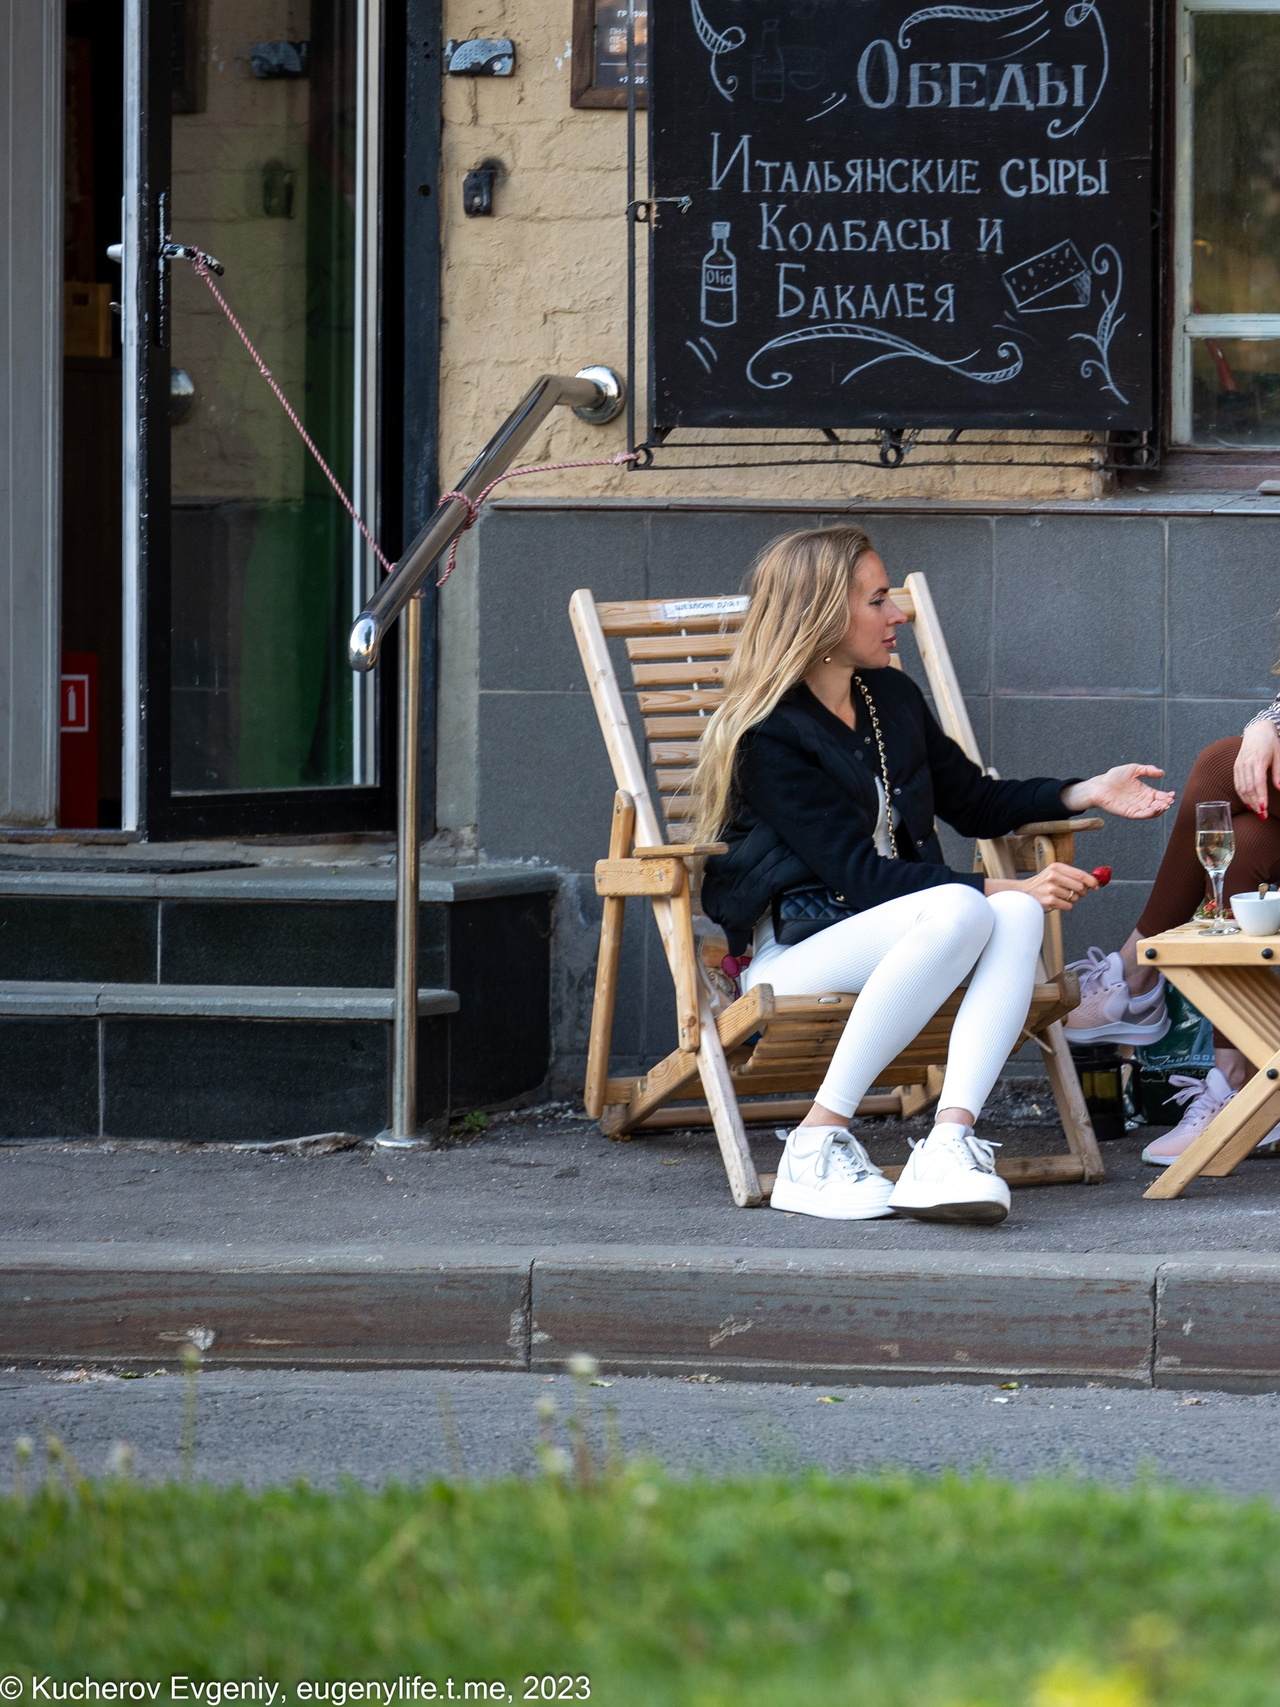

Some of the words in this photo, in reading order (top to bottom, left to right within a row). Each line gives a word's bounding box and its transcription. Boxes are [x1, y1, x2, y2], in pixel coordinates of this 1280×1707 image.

[857, 39, 1087, 111] ОБЕДЫ
[708, 132, 981, 194] ИТАЛЬЯНСКИЕ
[1000, 158, 1110, 197] СЫРЫ
[757, 203, 951, 253] КОЛБАСЫ
[977, 218, 1004, 254] И
[706, 270, 733, 286] Olio
[775, 263, 956, 323] БАКАЛЕЯ
